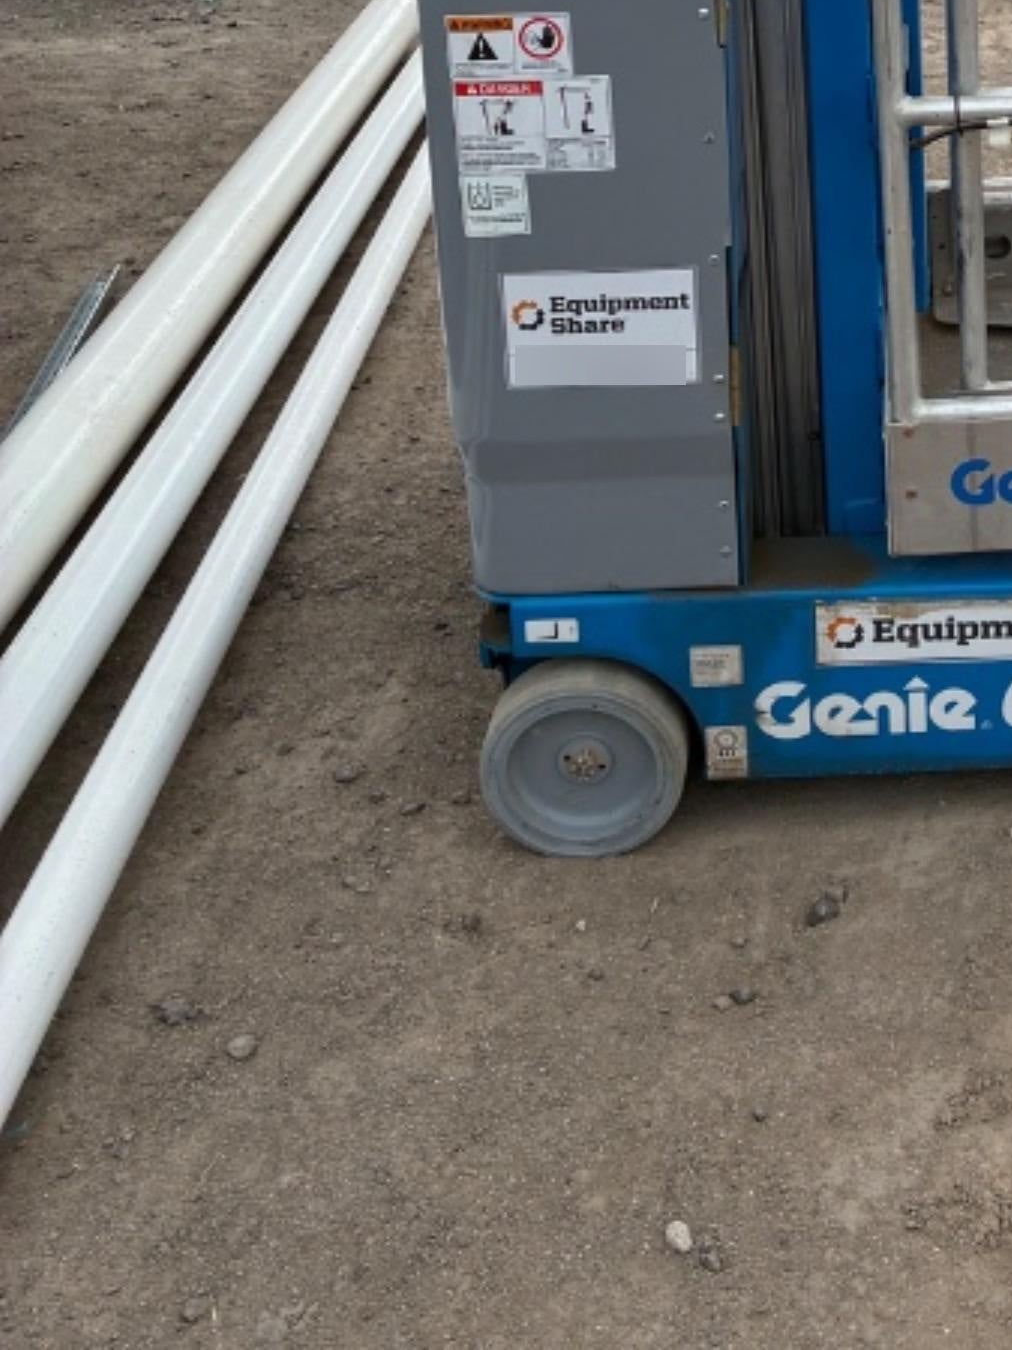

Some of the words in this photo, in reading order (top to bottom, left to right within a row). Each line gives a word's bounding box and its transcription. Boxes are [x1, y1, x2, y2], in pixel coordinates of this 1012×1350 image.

[549, 294, 690, 315] Equipment
[551, 317, 625, 334] Share
[755, 676, 977, 739] Genie
